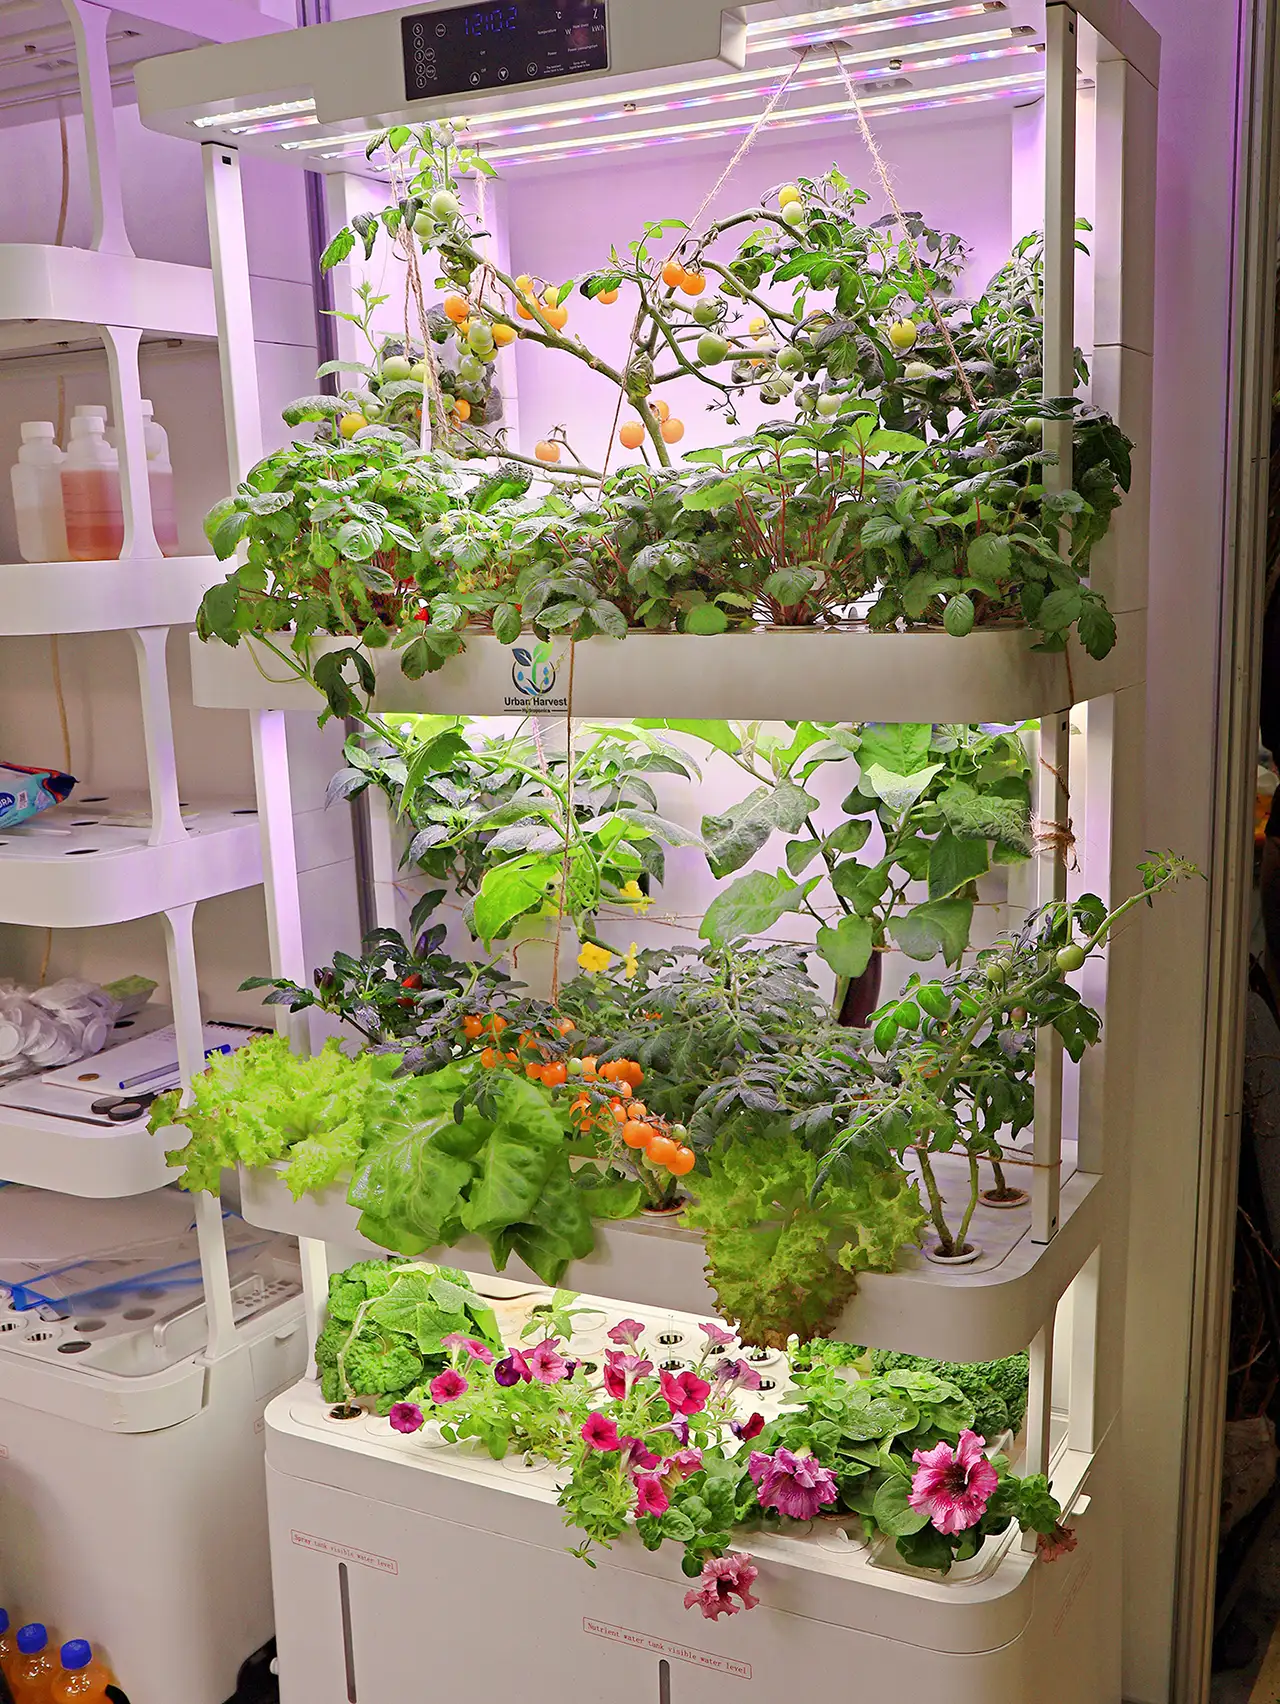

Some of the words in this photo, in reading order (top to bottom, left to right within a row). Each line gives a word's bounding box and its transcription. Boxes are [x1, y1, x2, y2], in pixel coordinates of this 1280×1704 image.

[504, 697, 531, 706] Urban
[533, 697, 568, 706] Harvest
[294, 1533, 311, 1545] Spray
[330, 1546, 354, 1558] visible
[357, 1554, 374, 1564] water
[377, 1559, 394, 1570] level
[587, 1622, 620, 1638] Nutrient
[623, 1634, 645, 1645] water
[667, 1645, 697, 1660] visible
[700, 1657, 722, 1667] water
[726, 1662, 747, 1675] level
